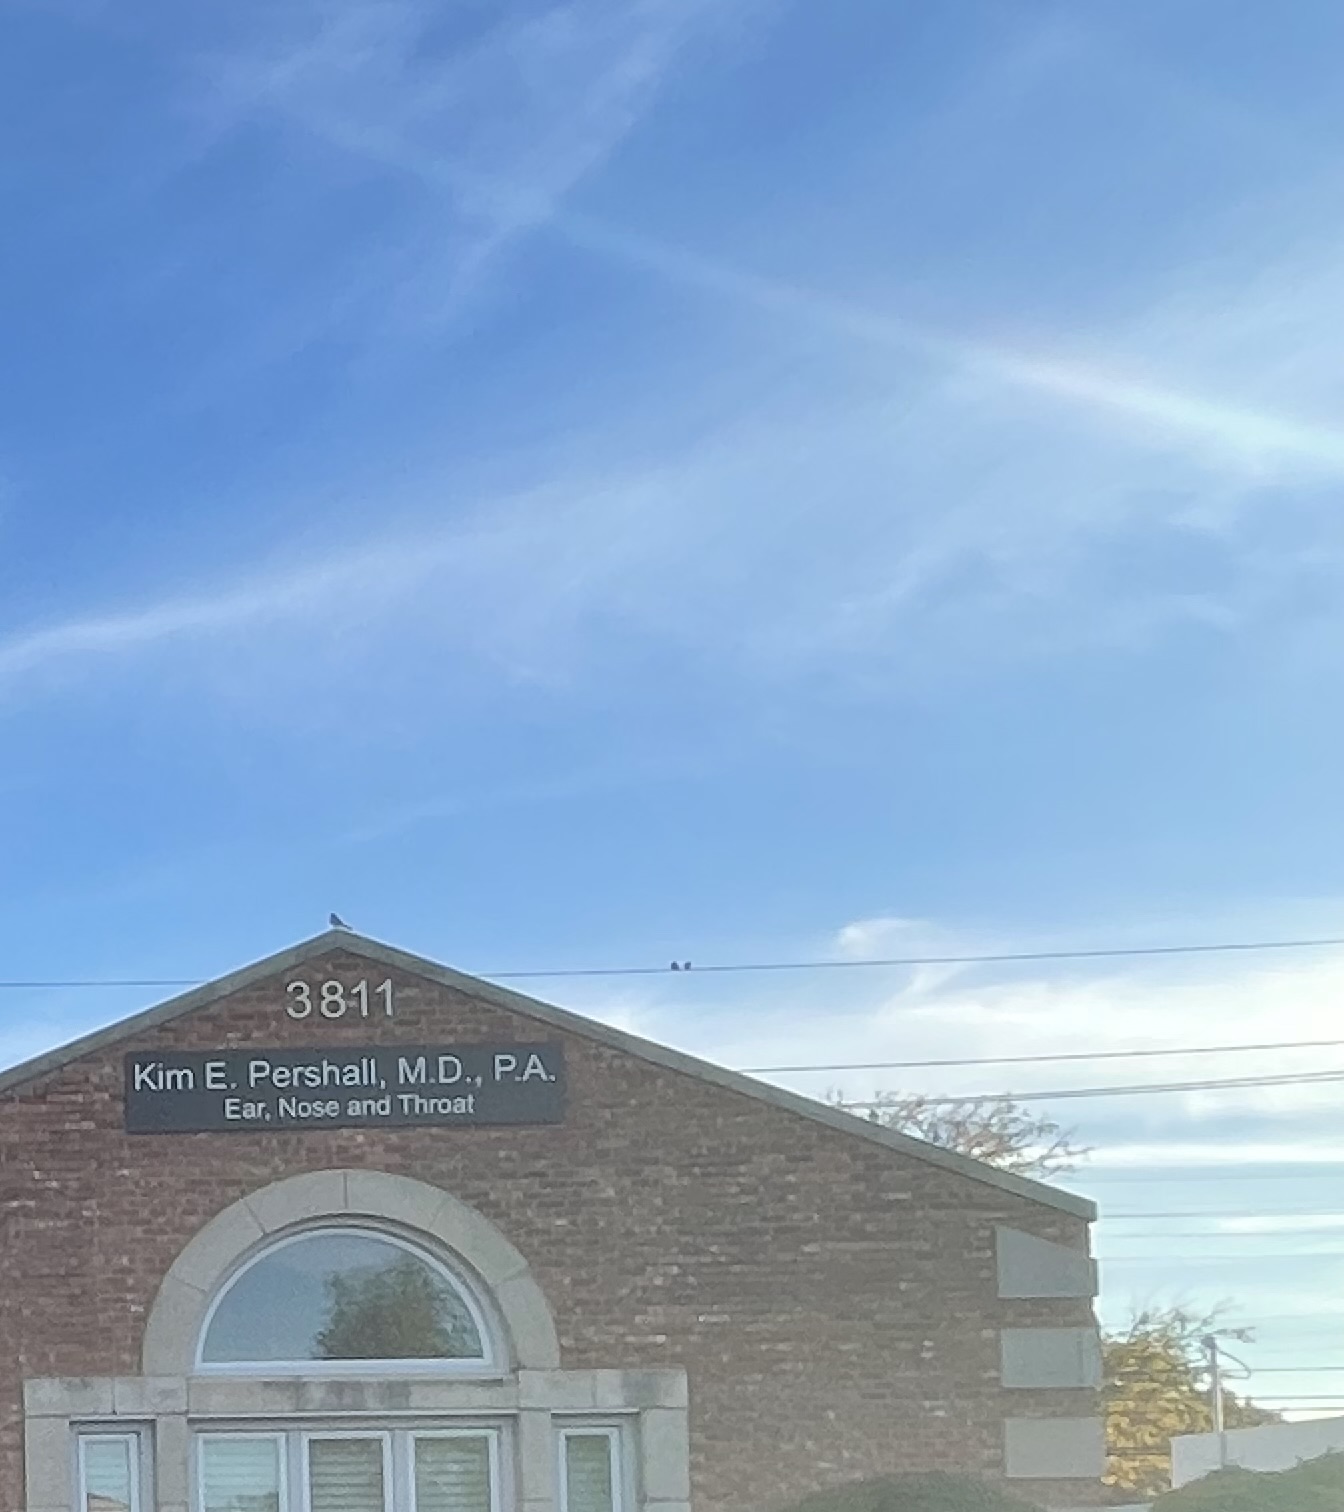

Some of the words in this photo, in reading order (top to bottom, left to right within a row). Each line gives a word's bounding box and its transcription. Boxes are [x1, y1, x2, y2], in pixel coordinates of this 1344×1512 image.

[286, 978, 395, 1018] 3811
[134, 1063, 193, 1090] Kim
[205, 1061, 236, 1089] E.
[249, 1058, 385, 1089] Pershall,
[398, 1056, 482, 1087] M.D.,
[494, 1054, 555, 1083] P.A.
[225, 1098, 270, 1121] Ear,
[278, 1097, 339, 1118] Nose
[346, 1095, 391, 1116] and
[398, 1094, 475, 1115] Throat
